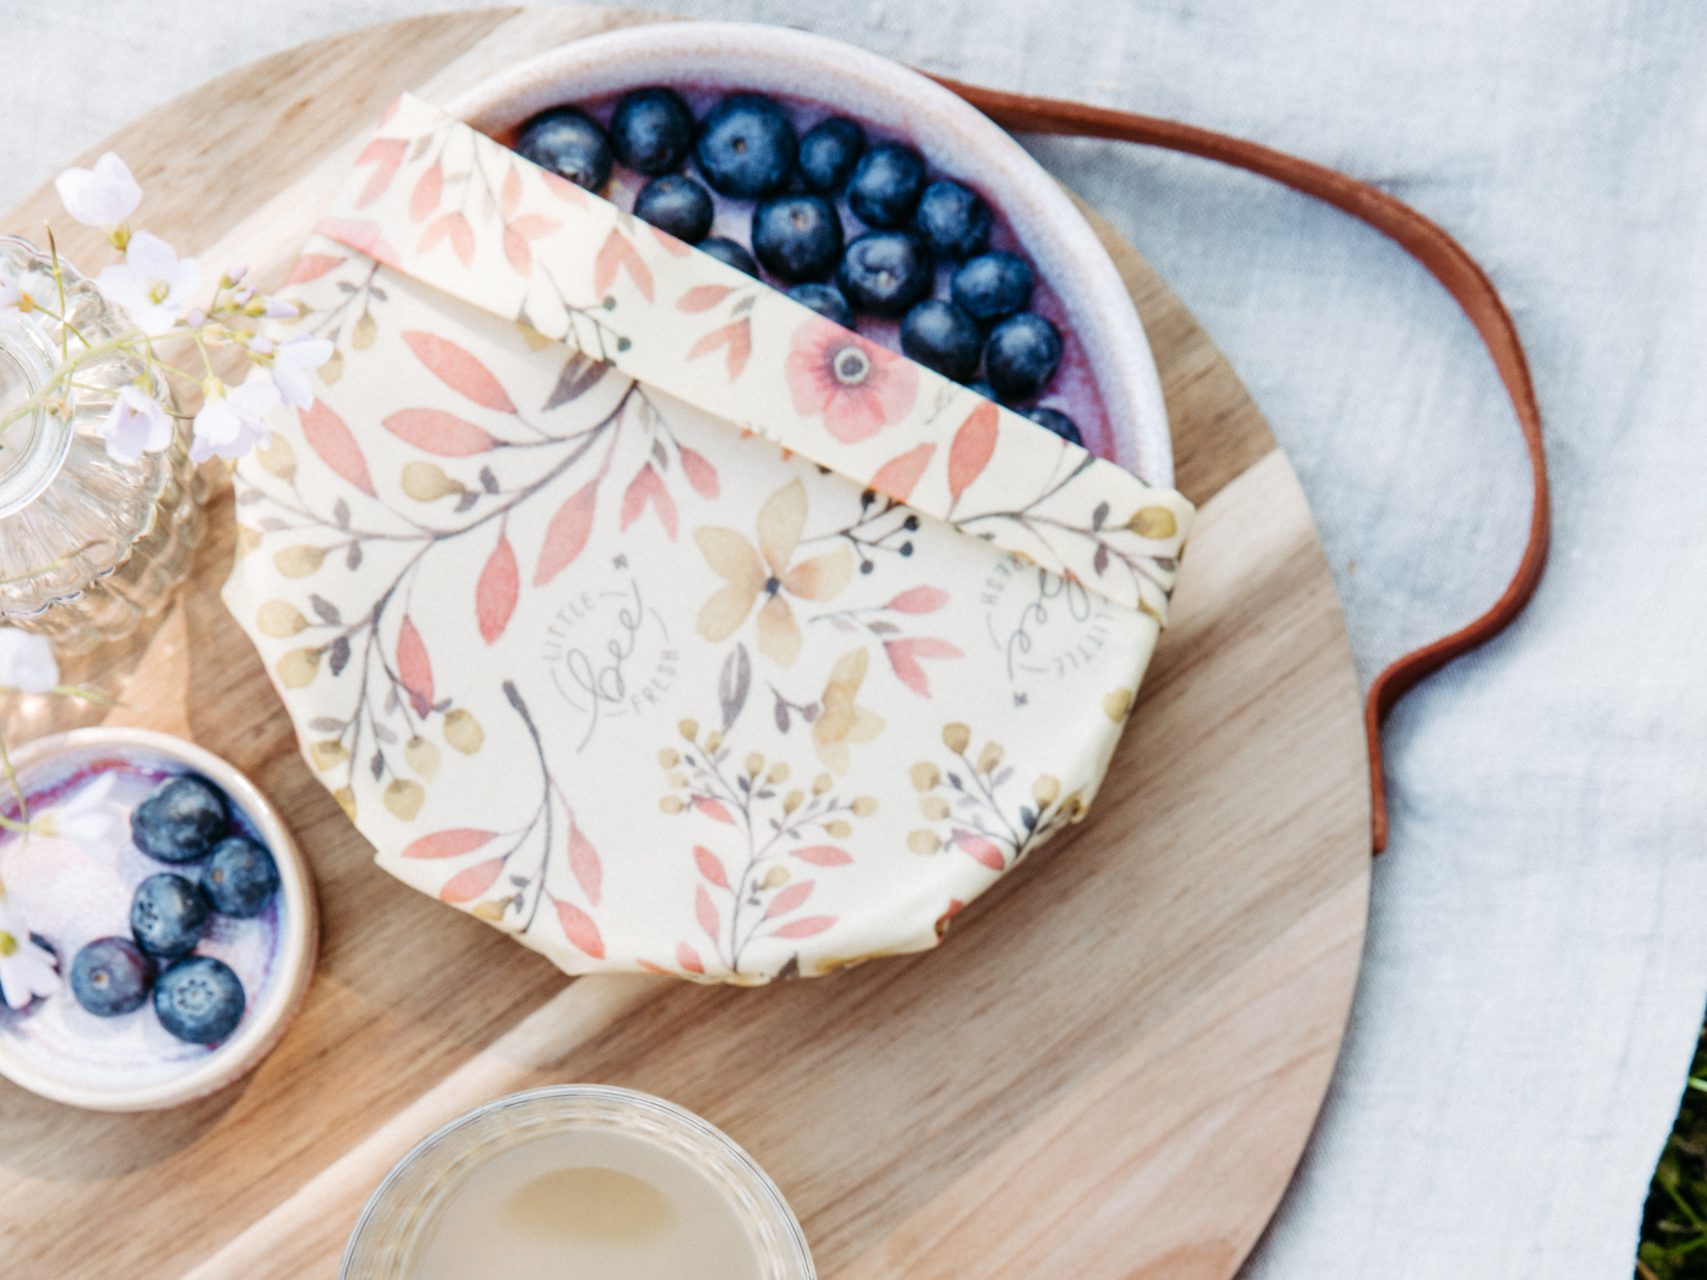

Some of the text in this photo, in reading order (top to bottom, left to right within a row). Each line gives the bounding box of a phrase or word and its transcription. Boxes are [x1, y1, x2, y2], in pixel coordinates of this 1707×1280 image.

[542, 591, 596, 661] LITTLE
[1054, 612, 1116, 677] LITTLE
[567, 578, 643, 753] bee
[630, 649, 680, 715] FRESH
